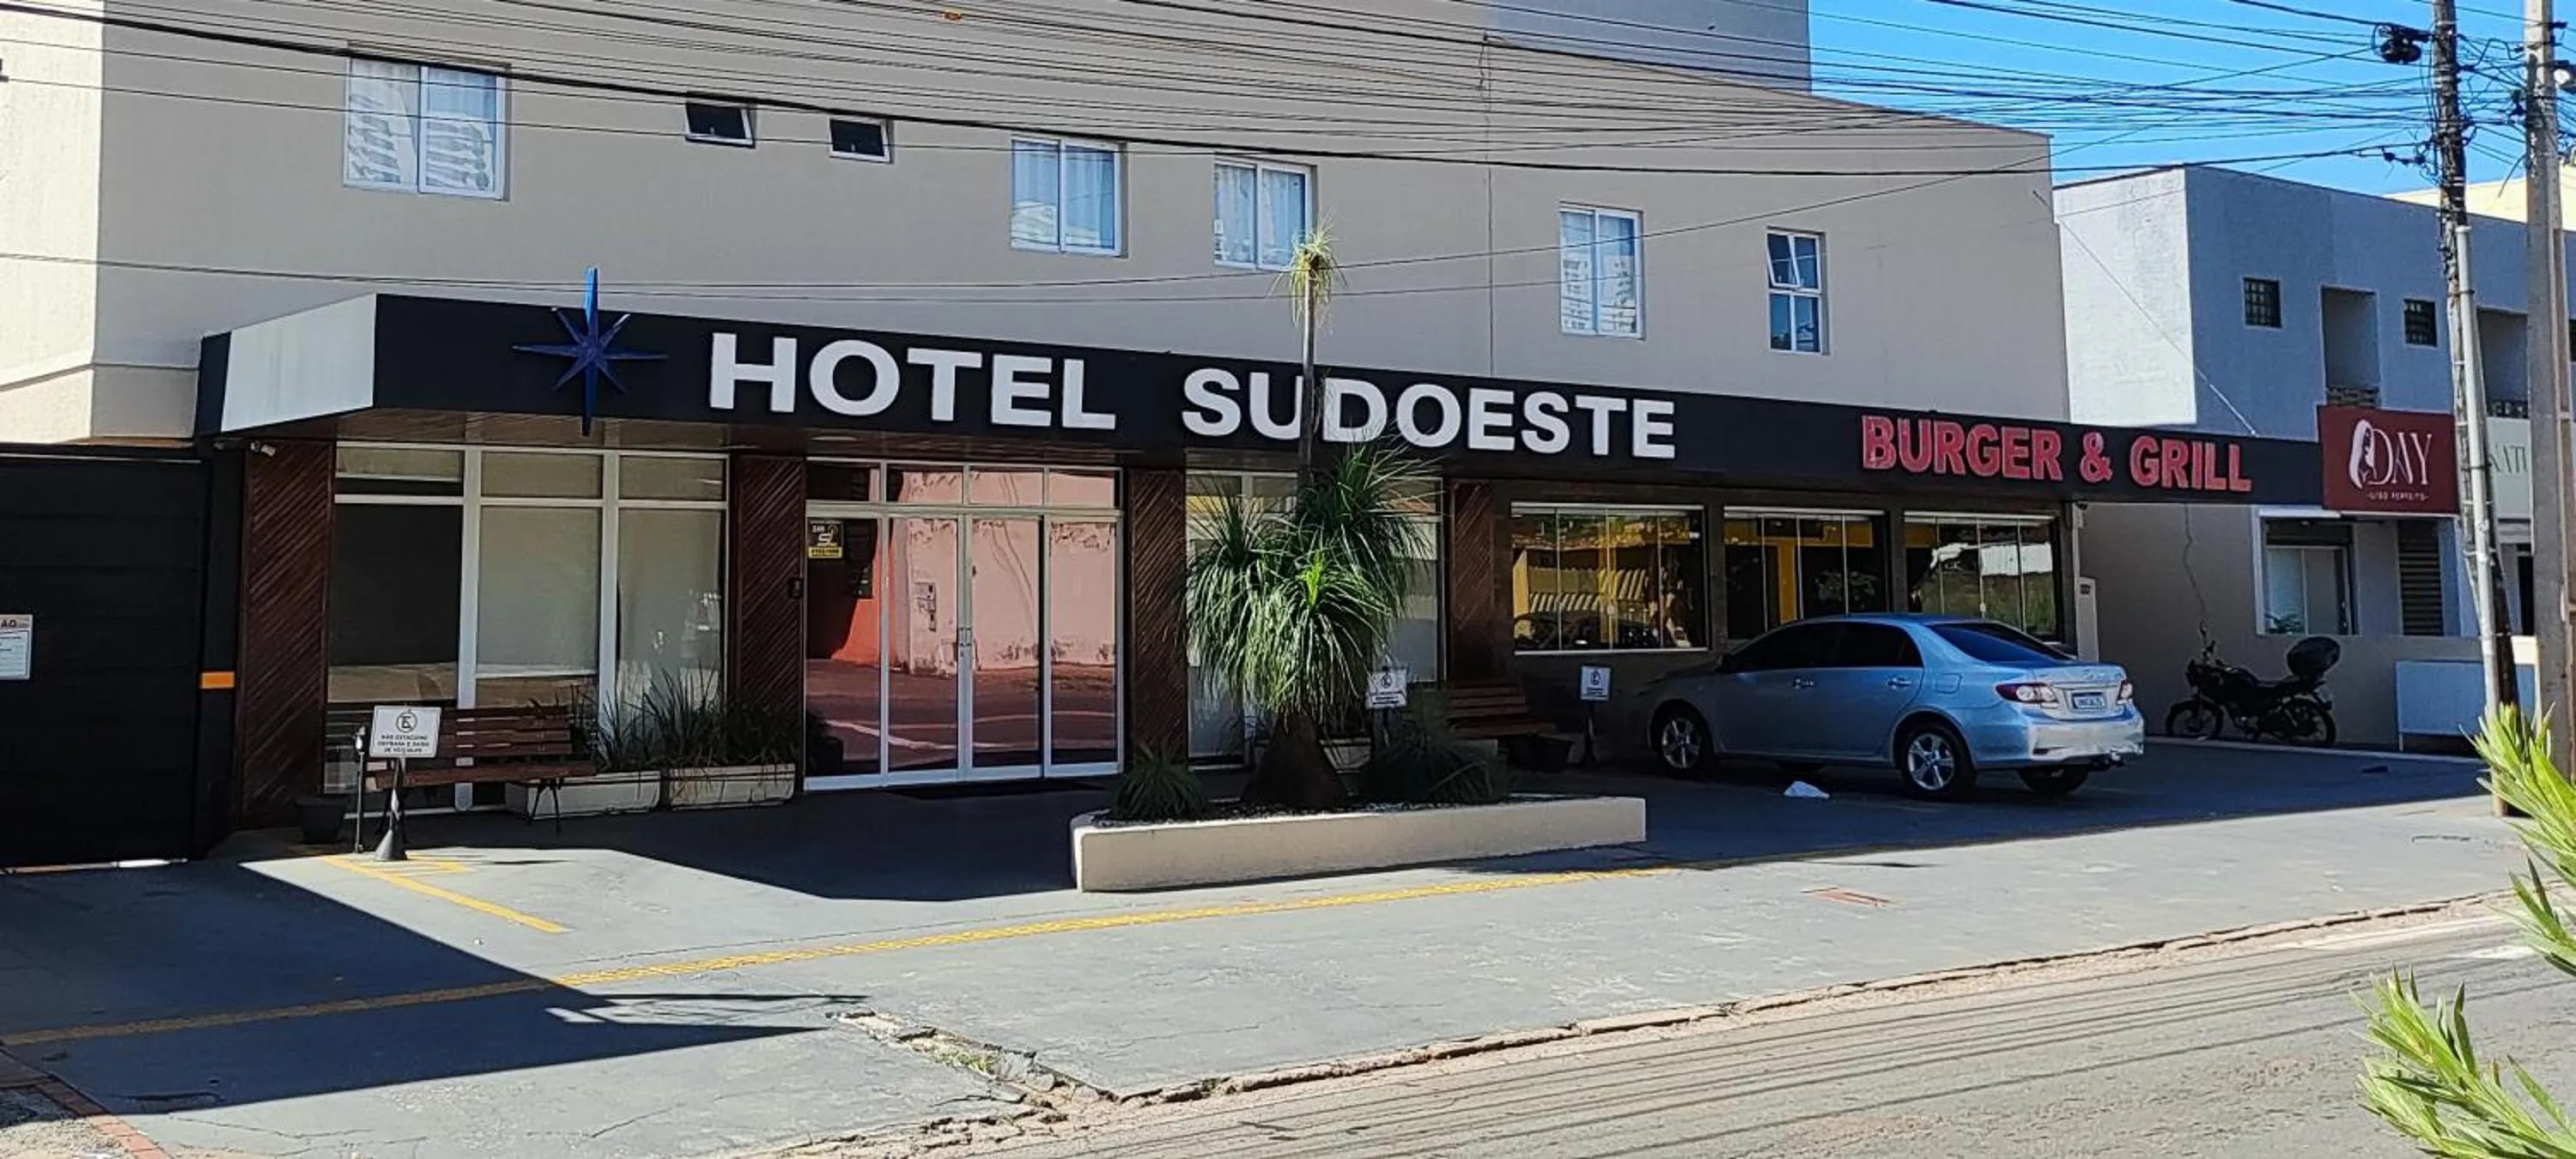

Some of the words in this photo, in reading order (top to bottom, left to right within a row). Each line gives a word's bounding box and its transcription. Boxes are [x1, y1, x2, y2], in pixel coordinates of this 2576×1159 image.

[709, 332, 1116, 429] HOTEL
[1182, 368, 1676, 459] SUDOESTE
[1862, 415, 2063, 482] BURGER
[2080, 432, 2113, 482] &
[2129, 435, 2252, 492] GRILL
[2367, 428, 2433, 485] DAY
